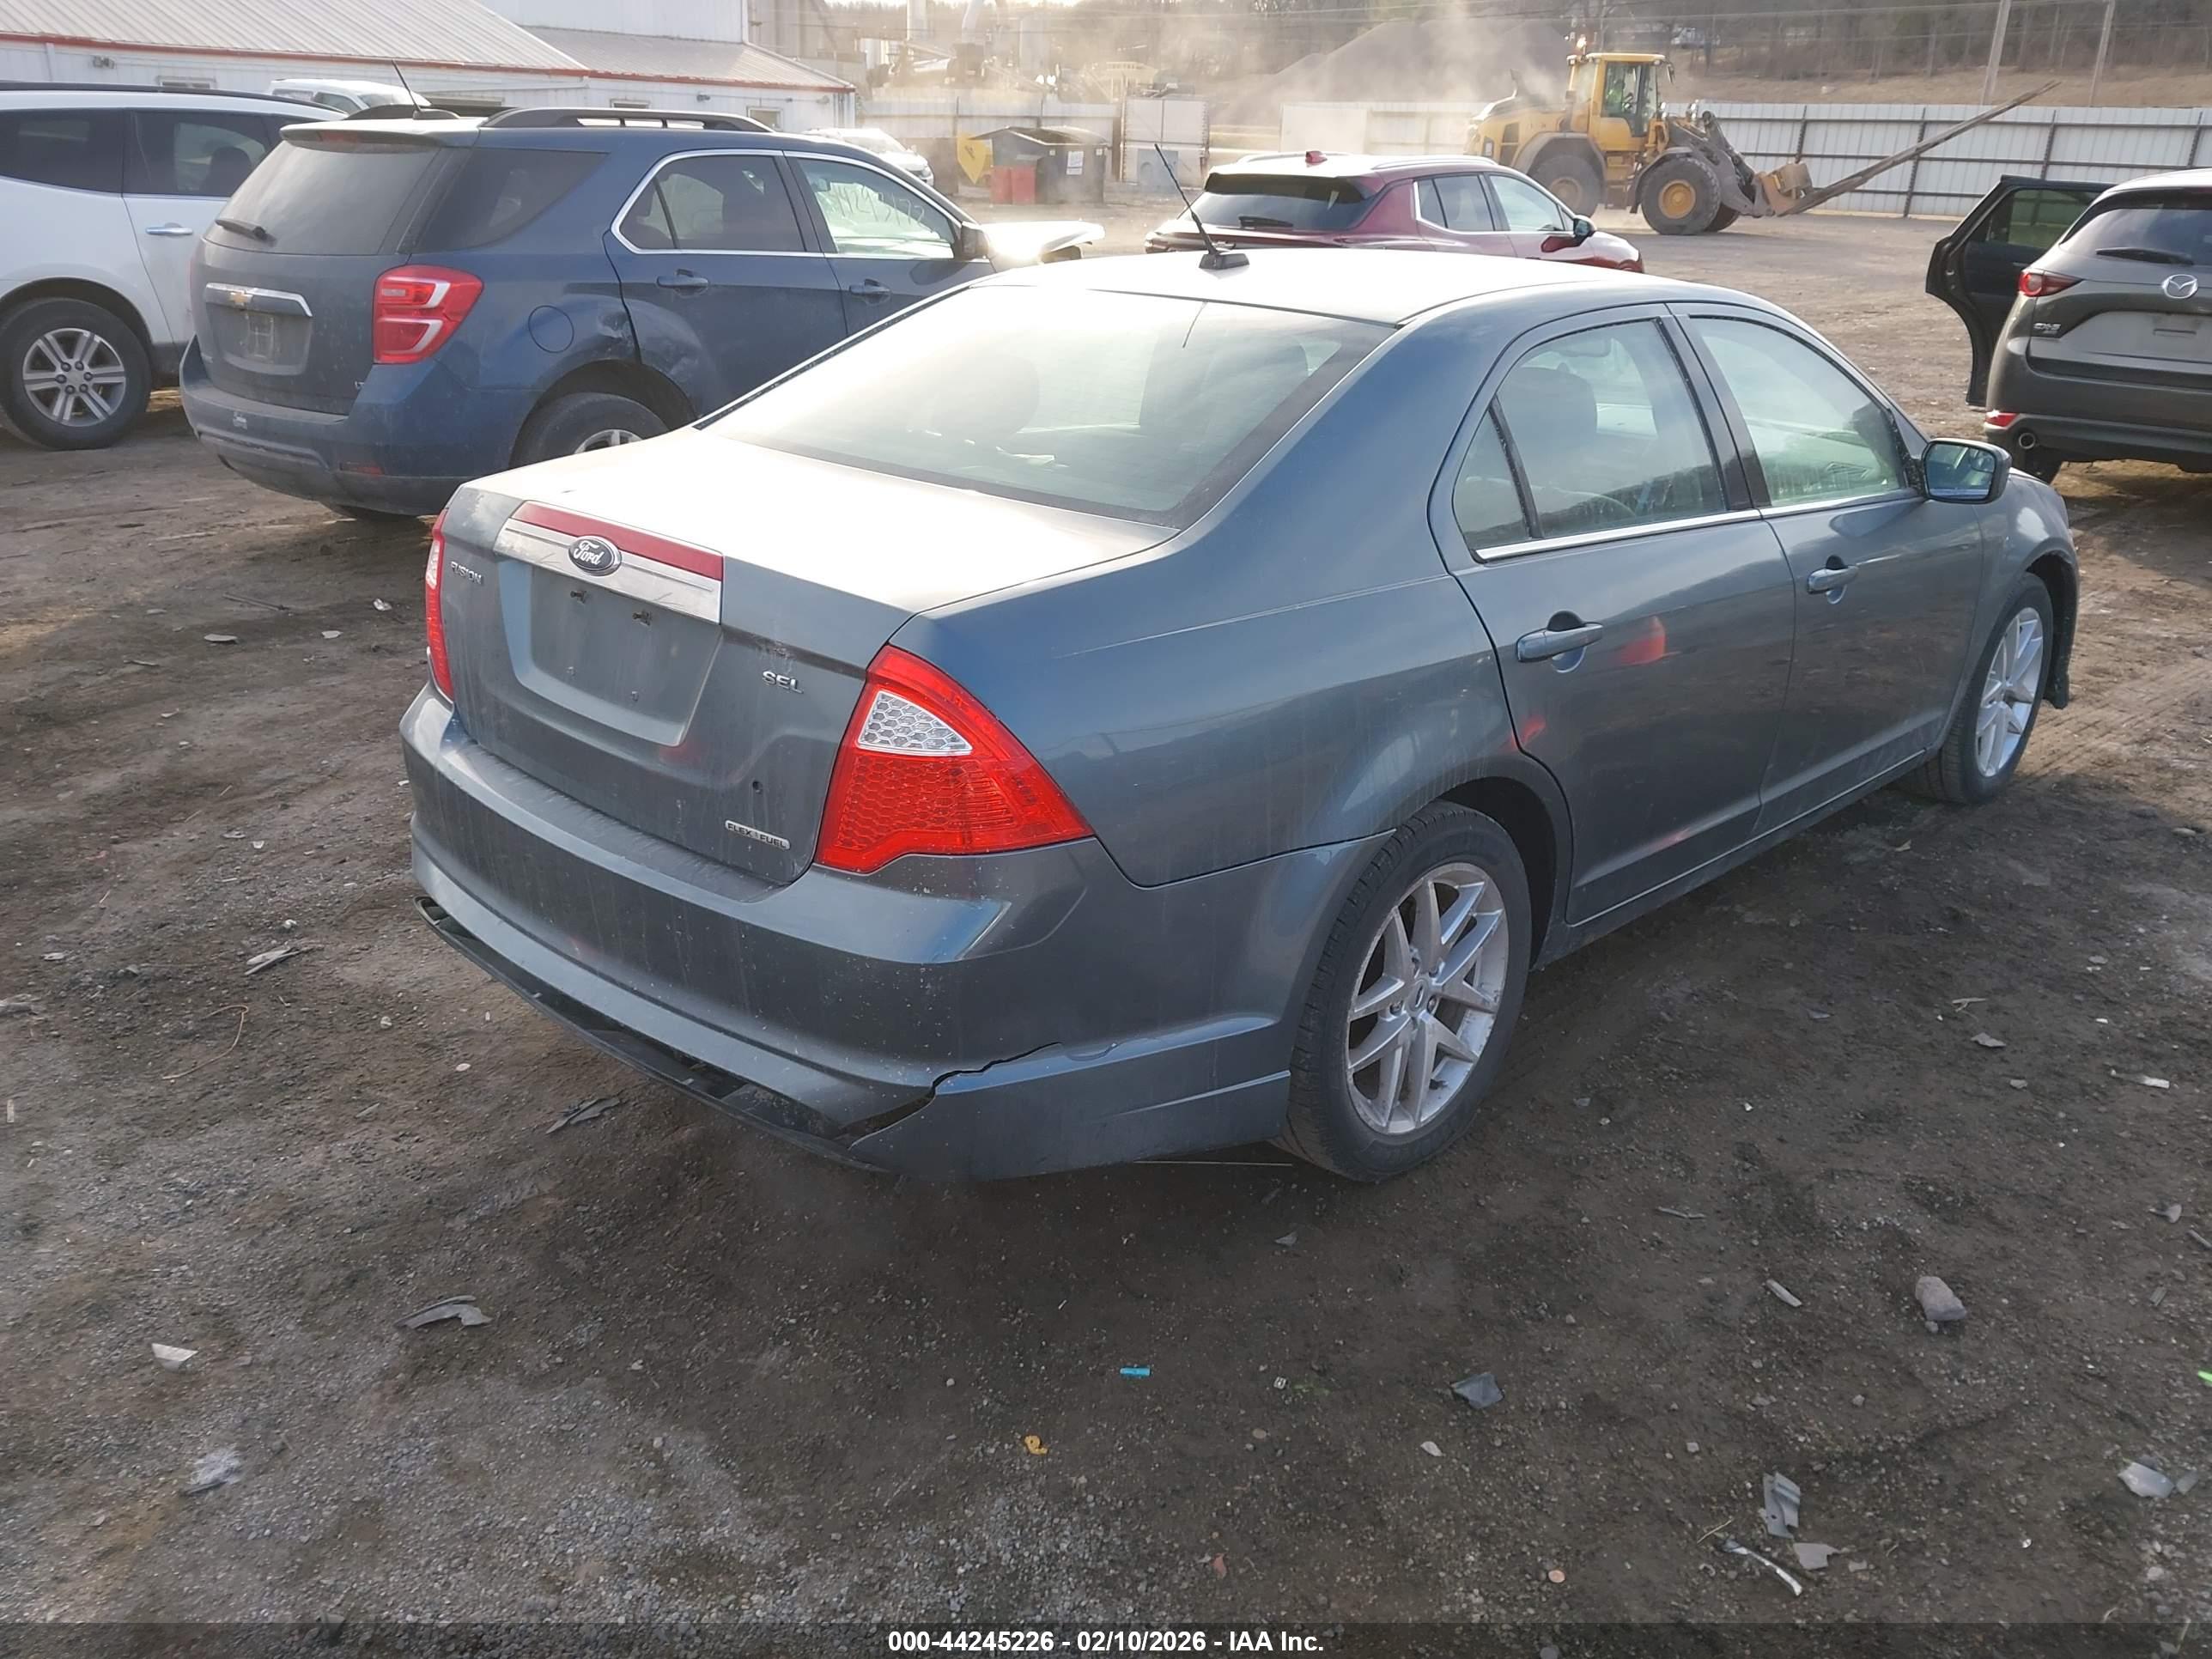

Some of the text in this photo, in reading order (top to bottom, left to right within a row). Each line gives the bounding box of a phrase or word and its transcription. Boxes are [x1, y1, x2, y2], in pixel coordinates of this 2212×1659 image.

[573, 540, 605, 565] Ford
[450, 561, 482, 585] FUSION
[763, 671, 804, 694] SEL
[727, 823, 787, 848] FLEX FUEL
